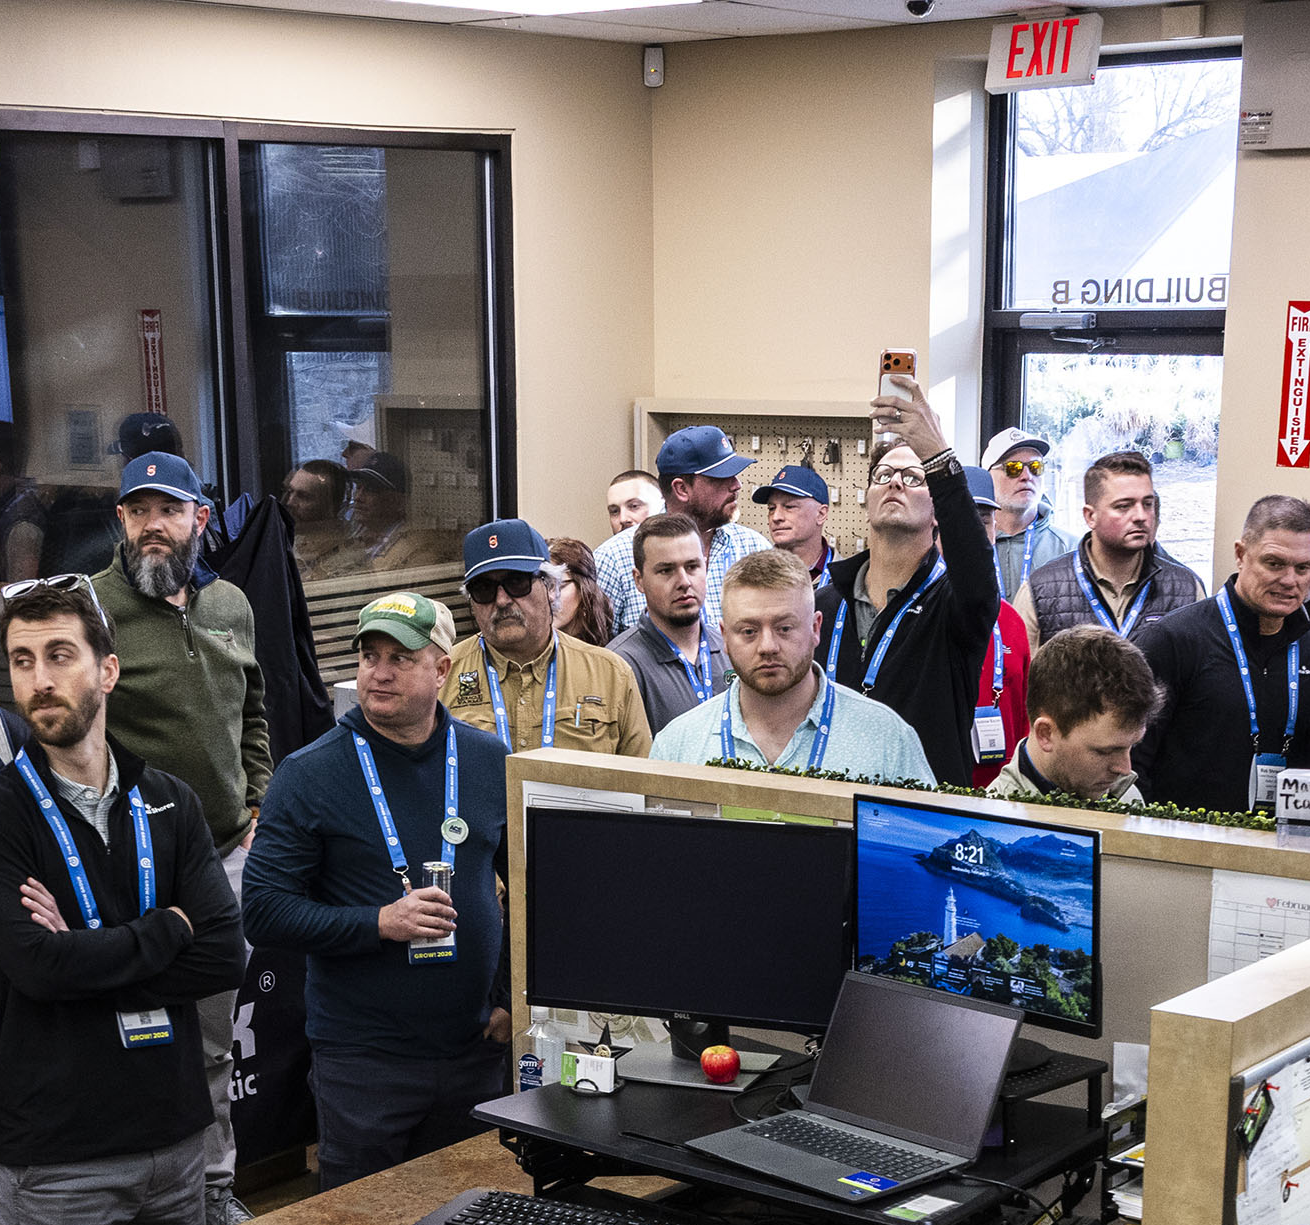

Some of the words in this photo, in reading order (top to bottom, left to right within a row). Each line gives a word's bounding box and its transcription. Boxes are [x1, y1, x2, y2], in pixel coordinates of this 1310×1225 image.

[1006, 18, 1080, 79] EXIT
[1289, 338, 1307, 456] EXTINGUISHER
[954, 842, 985, 865] 8:21
[129, 1033, 152, 1042] GROW!
[153, 1031, 170, 1039] 2026
